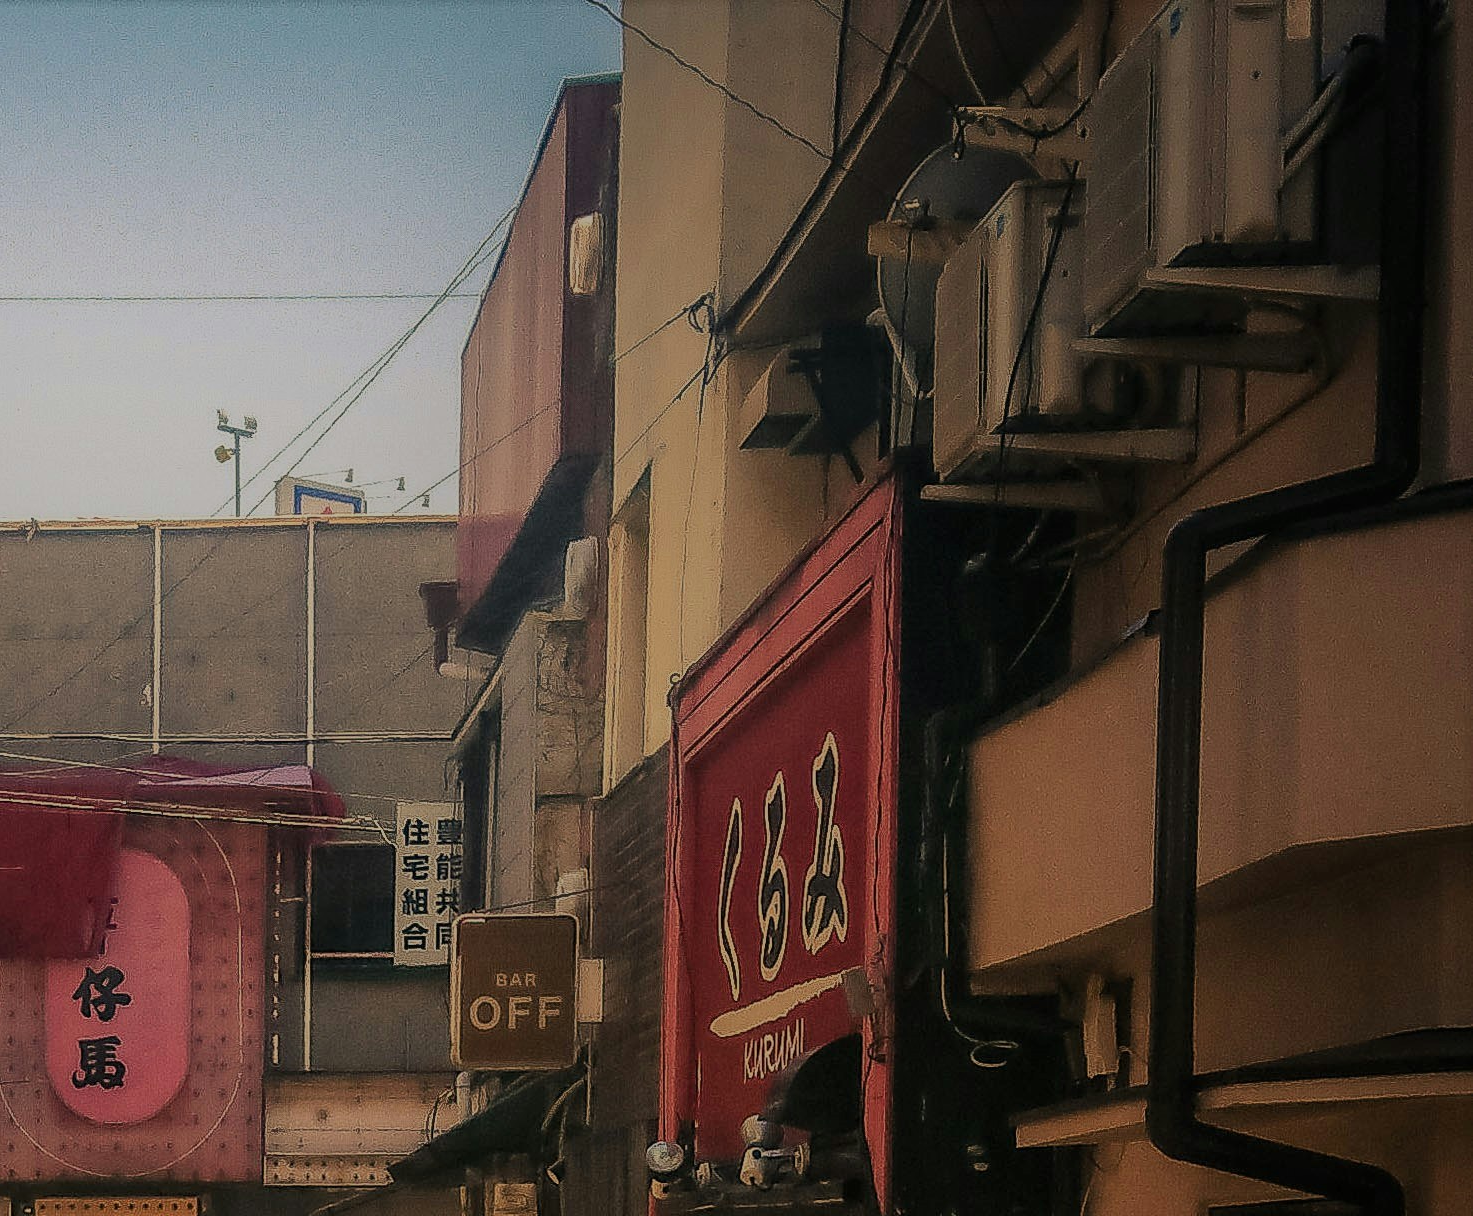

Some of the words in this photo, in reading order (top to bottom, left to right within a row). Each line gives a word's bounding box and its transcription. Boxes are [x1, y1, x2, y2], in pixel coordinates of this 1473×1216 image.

[401, 818, 429, 951] 住宅組合
[718, 732, 848, 1001] くるみ
[469, 996, 563, 1030] OFF
[495, 973, 537, 988] BAR
[743, 1017, 805, 1084] KURUMI
